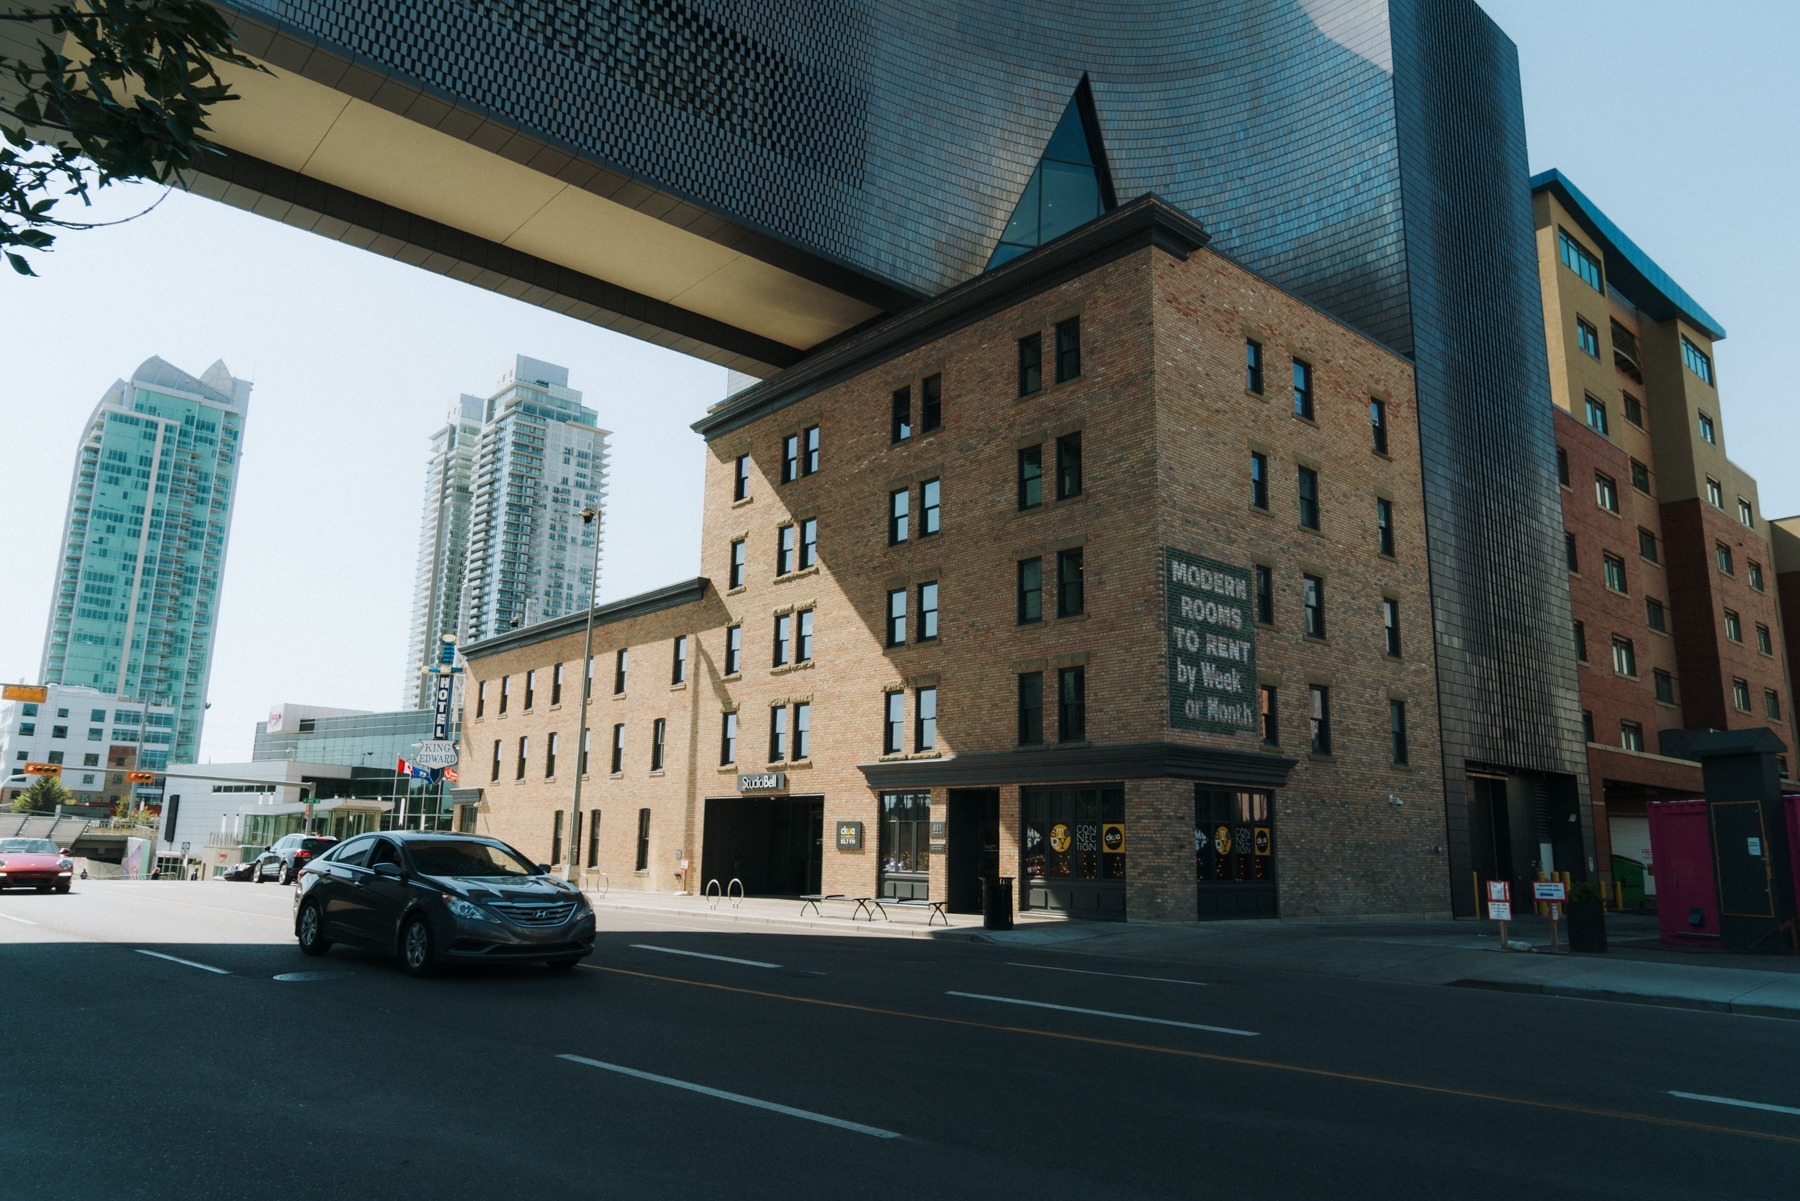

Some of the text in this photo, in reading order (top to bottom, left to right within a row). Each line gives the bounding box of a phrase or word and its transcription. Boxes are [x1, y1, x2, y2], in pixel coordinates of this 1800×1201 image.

[1172, 560, 1247, 600] MODERN
[1181, 595, 1243, 630] ROOMS
[1173, 627, 1251, 664] TO RENT
[1177, 657, 1242, 693] by Week
[436, 677, 449, 738] HOTEL
[1185, 697, 1253, 726] or Month
[419, 754, 457, 764] EDWARD
[425, 743, 451, 752] KING
[1076, 825, 1097, 833] CON
[1076, 833, 1097, 843] NEC
